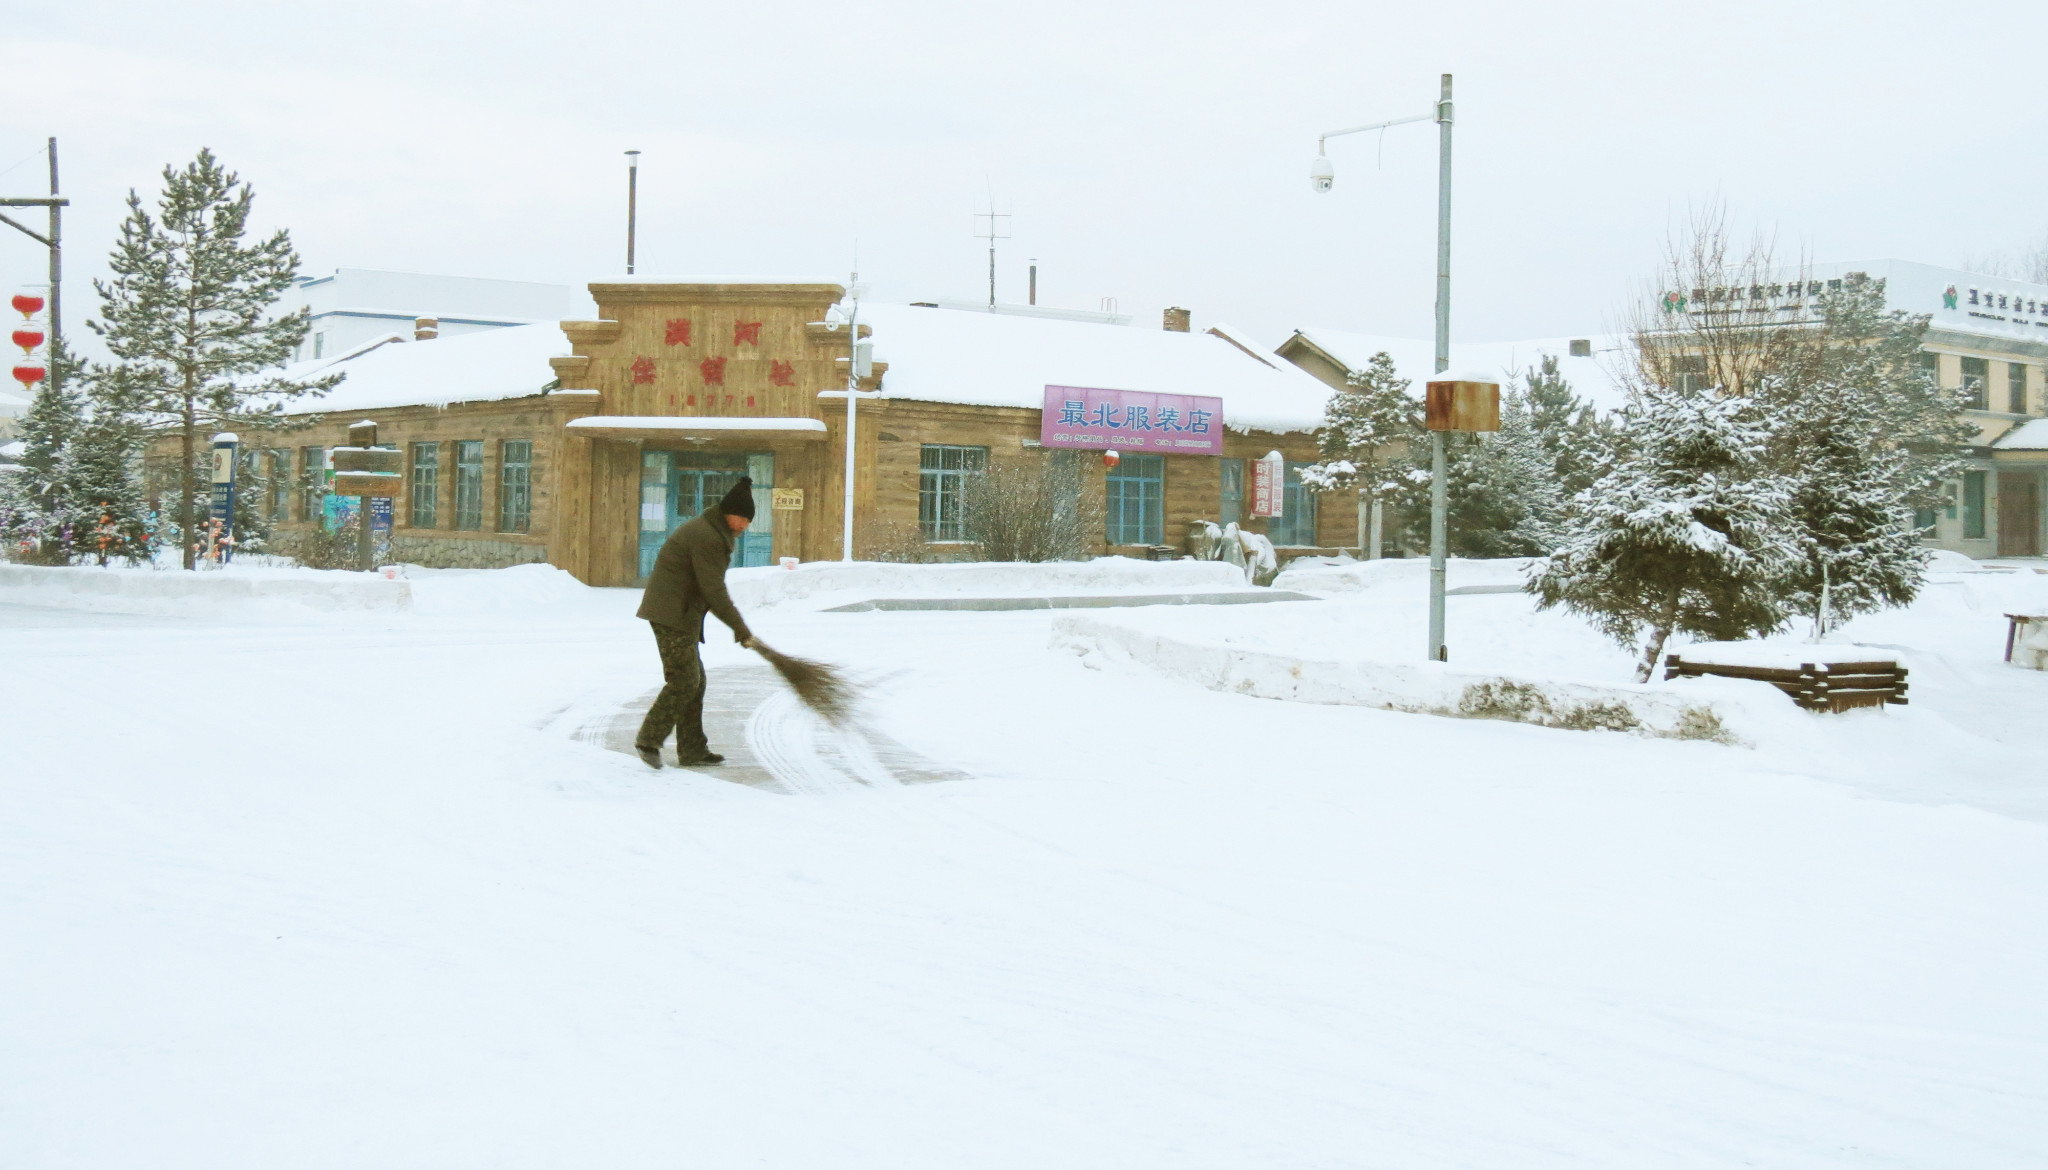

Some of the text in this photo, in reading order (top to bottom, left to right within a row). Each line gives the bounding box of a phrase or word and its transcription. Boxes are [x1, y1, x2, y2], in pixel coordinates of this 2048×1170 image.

[1057, 400, 1213, 435] 最北服装店
[1255, 462, 1270, 513] 时装商店
